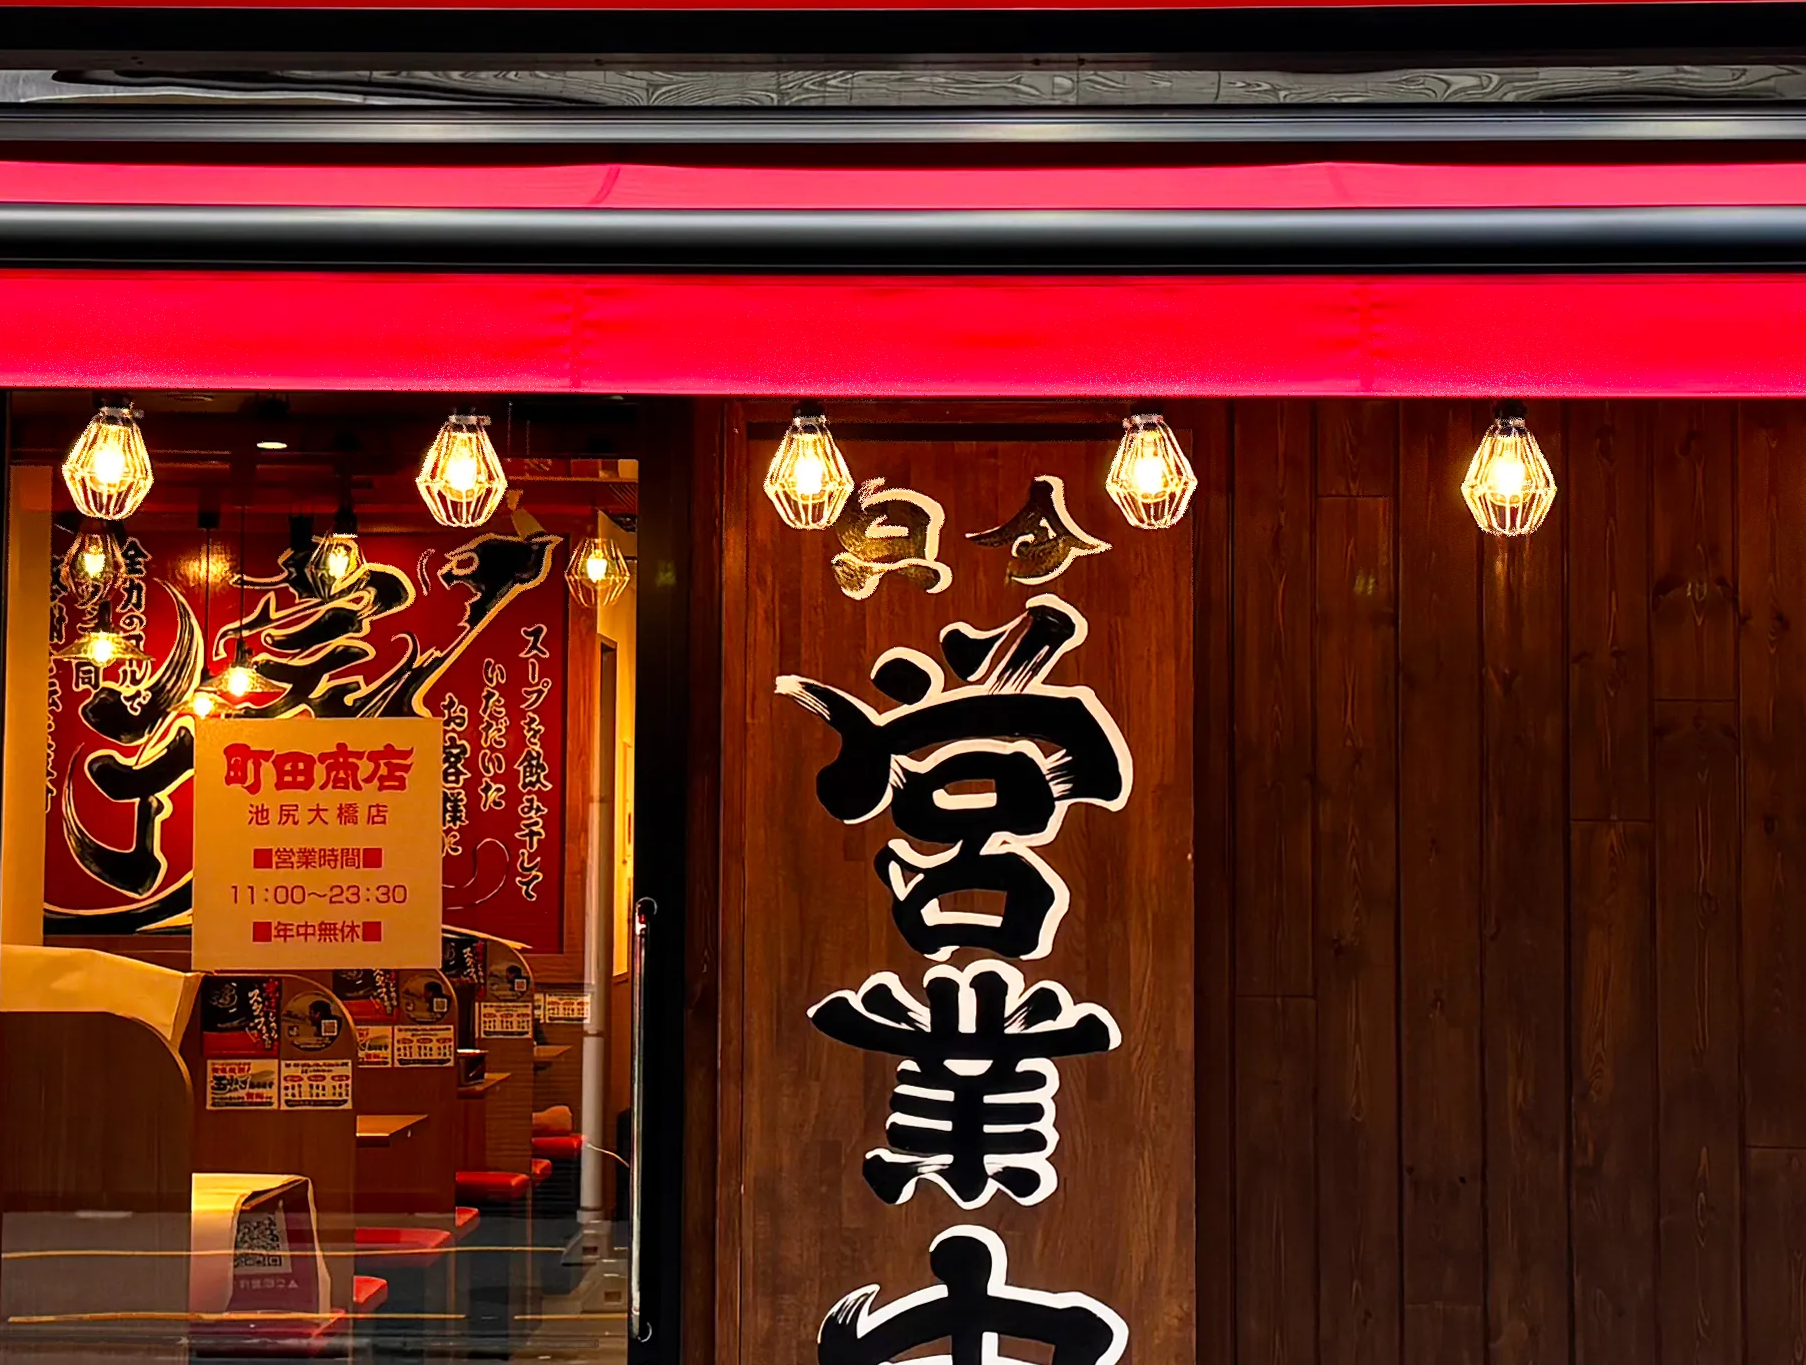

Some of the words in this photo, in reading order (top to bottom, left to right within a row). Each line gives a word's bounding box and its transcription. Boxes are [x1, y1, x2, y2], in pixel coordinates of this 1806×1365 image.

[223, 742, 415, 793] 町田商店
[478, 658, 509, 812] いただいた
[514, 623, 553, 901] スープを飲み干して
[248, 802, 389, 827] 池尻大橋店
